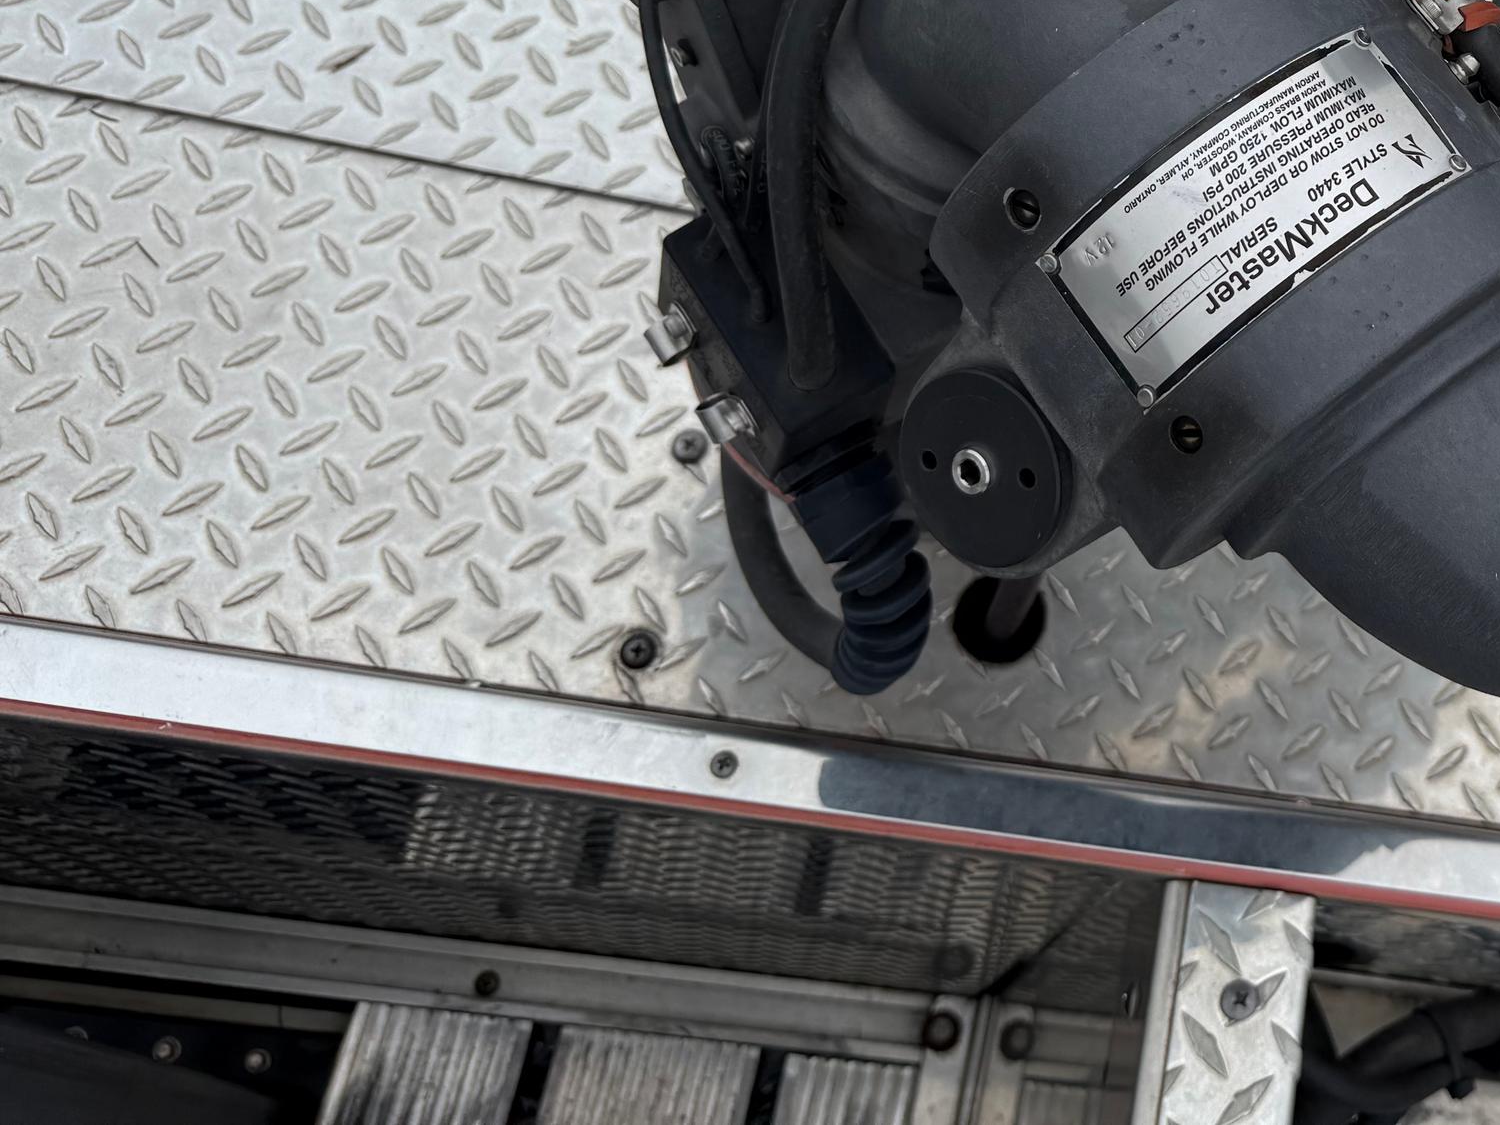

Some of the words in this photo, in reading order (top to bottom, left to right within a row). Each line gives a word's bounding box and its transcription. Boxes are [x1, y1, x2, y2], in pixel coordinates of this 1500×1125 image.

[1294, 70, 1319, 89] AKRON
[1303, 75, 1356, 112] MAXIMUM
[1230, 85, 1294, 131] MANUFACTURING
[1274, 94, 1301, 114] BRASS
[1345, 103, 1375, 123] READ
[1234, 111, 1274, 140] COMPANY,
[1368, 113, 1385, 128] DO
[1189, 128, 1229, 160] COMPANY,
[1193, 137, 1236, 169] WOOSTER,
[1239, 133, 1267, 154] 1250
[1247, 118, 1313, 168] PRESSURE
[1277, 118, 1344, 166] OPERATING
[1310, 136, 1343, 165] STOW
[1156, 156, 1188, 185] AYLMER,
[1181, 167, 1193, 180] OH
[1209, 150, 1237, 176] GPM
[1225, 162, 1246, 184] 200
[1288, 160, 1307, 178] OR
[1341, 143, 1387, 178] STYLE
[1124, 183, 1156, 213] ONTARIO
[1186, 161, 1276, 234] INSTRUCTIONS
[1202, 179, 1224, 202] PSI
[1240, 173, 1288, 216] DEPLOY
[1307, 171, 1341, 201] 3440
[1197, 210, 1239, 246] WHILE
[1220, 216, 1277, 268] SERIAL
[1138, 229, 1186, 276] BEFORE
[1205, 177, 1379, 314] DeckMaster
[1144, 240, 1198, 291] FLOWING
[1115, 270, 1139, 297] USE
